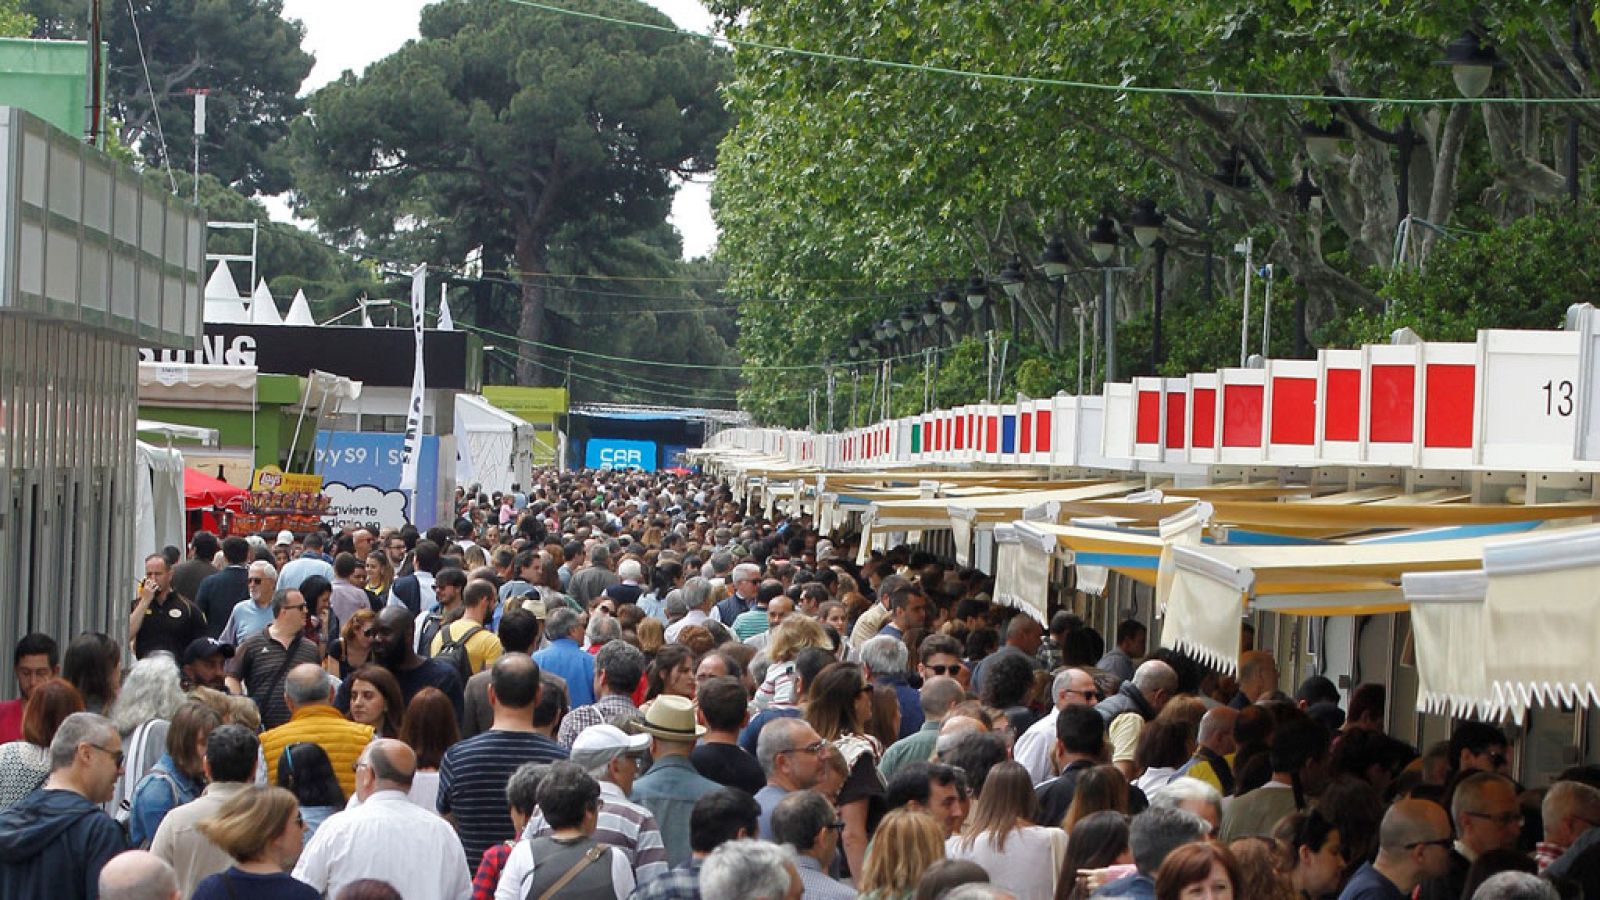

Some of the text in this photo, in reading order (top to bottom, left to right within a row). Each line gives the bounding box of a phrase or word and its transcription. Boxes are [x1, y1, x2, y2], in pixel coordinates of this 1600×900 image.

[139, 335, 257, 365] NG
[1542, 380, 1573, 416] 13
[315, 448, 342, 468] xy
[344, 447, 367, 464] S9
[600, 448, 641, 463] CAR
